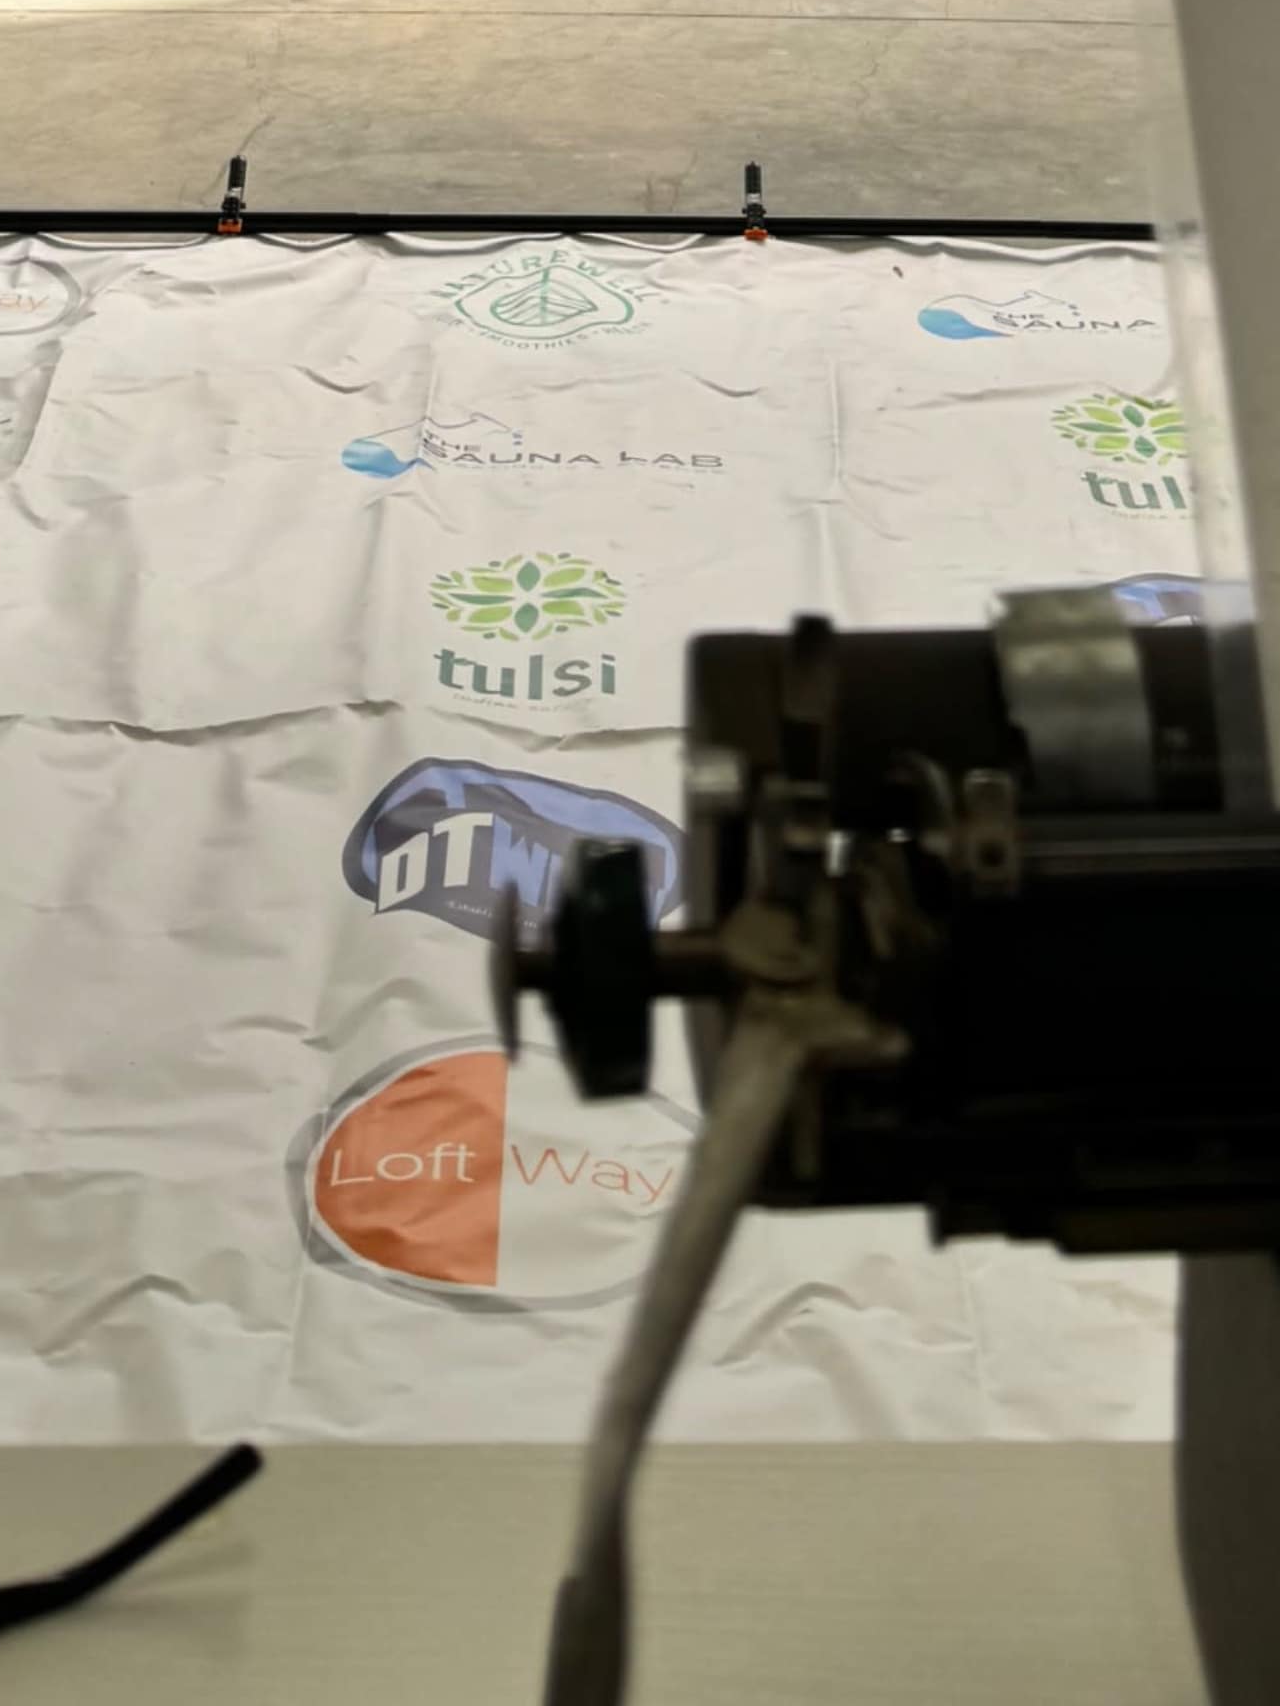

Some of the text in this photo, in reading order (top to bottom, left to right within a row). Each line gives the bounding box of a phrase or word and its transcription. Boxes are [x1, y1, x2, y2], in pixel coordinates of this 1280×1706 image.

[619, 450, 724, 469] LAB
[1080, 471, 1188, 510] tul
[433, 648, 617, 701] tulsi
[329, 1142, 676, 1206] Loft Way
